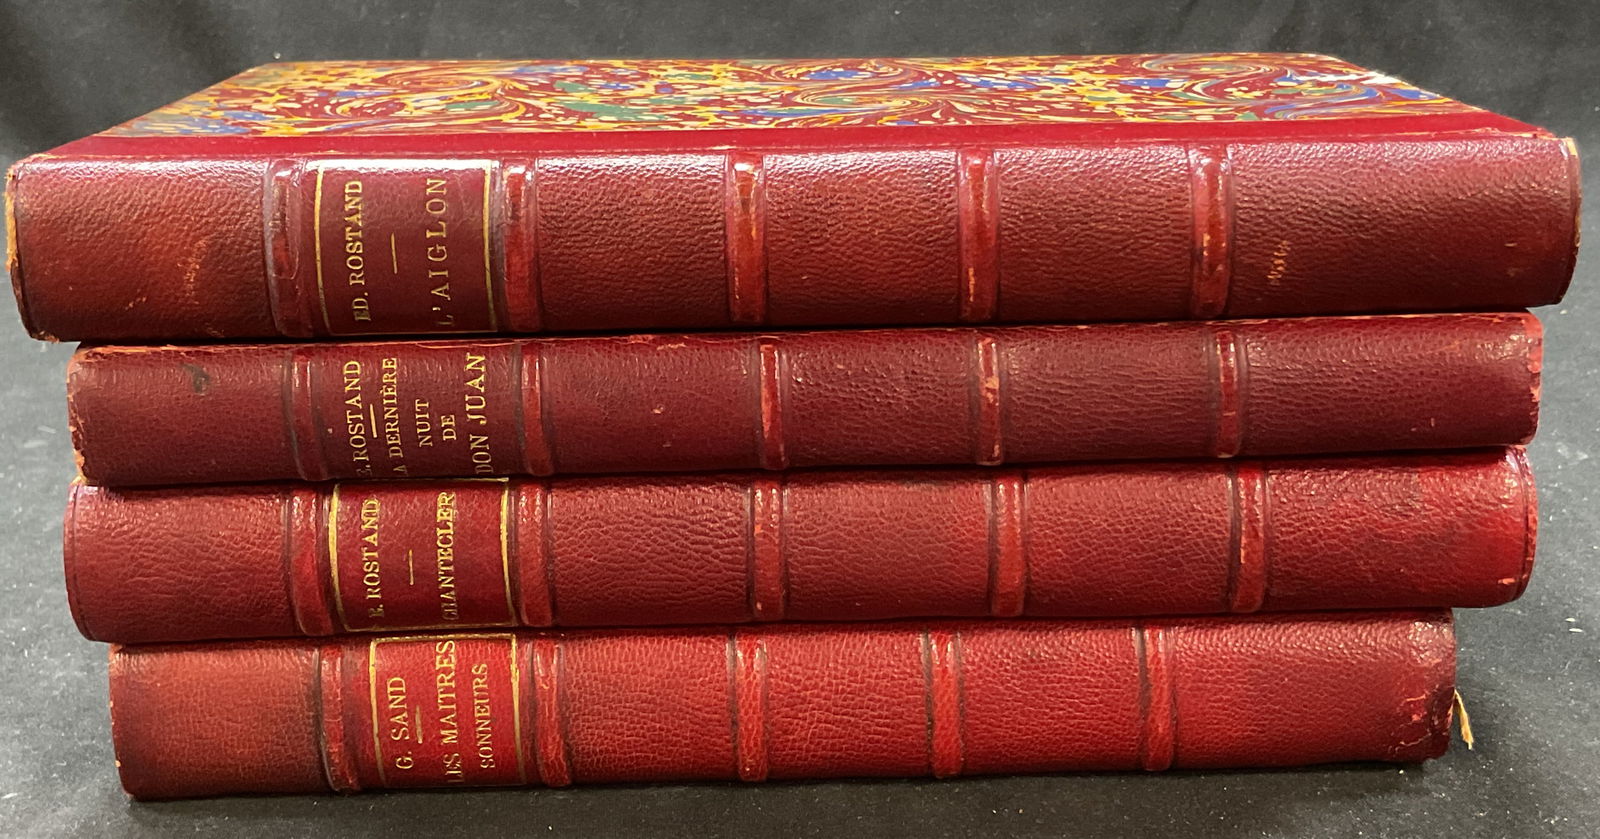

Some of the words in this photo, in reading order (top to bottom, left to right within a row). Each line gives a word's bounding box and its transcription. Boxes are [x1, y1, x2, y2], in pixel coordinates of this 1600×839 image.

[344, 180, 366, 286] ROSTAND
[426, 178, 454, 326] L'AIGLON
[352, 292, 371, 321] ED.
[343, 360, 369, 462] ROSTAND
[380, 357, 403, 458] DERNIÈRE
[415, 399, 433, 447] NUIT
[441, 414, 457, 441] DE
[464, 352, 487, 425] JUAN
[470, 434, 494, 475] DON
[361, 498, 381, 600] ROSTAND
[436, 491, 458, 621] CHANTECLER
[387, 677, 410, 740] SAND
[435, 640, 458, 745] MAITRES
[471, 663, 495, 769] SONNEURS
[395, 751, 414, 769] G.
